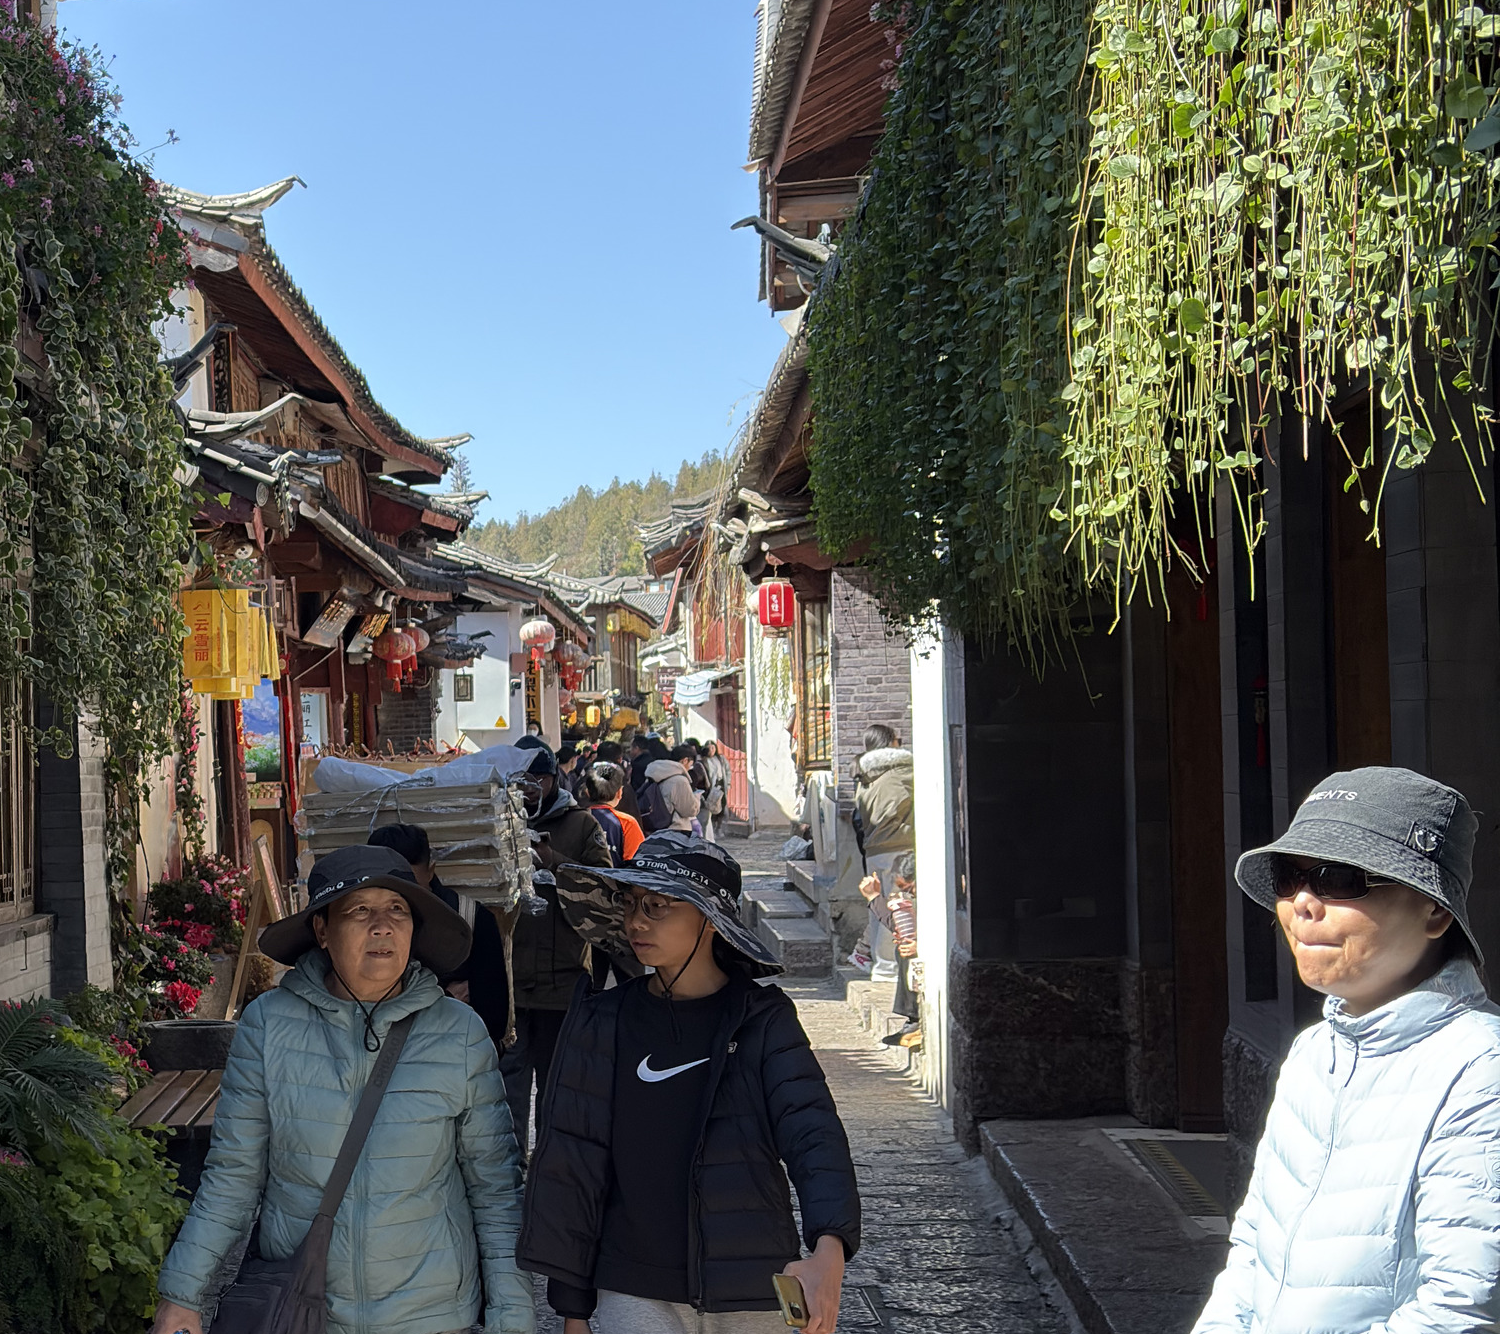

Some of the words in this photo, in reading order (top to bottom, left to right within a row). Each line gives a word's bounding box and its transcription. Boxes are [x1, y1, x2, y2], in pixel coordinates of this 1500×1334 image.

[193, 618, 210, 662] 云雪丽
[646, 860, 691, 877] TORNDO
